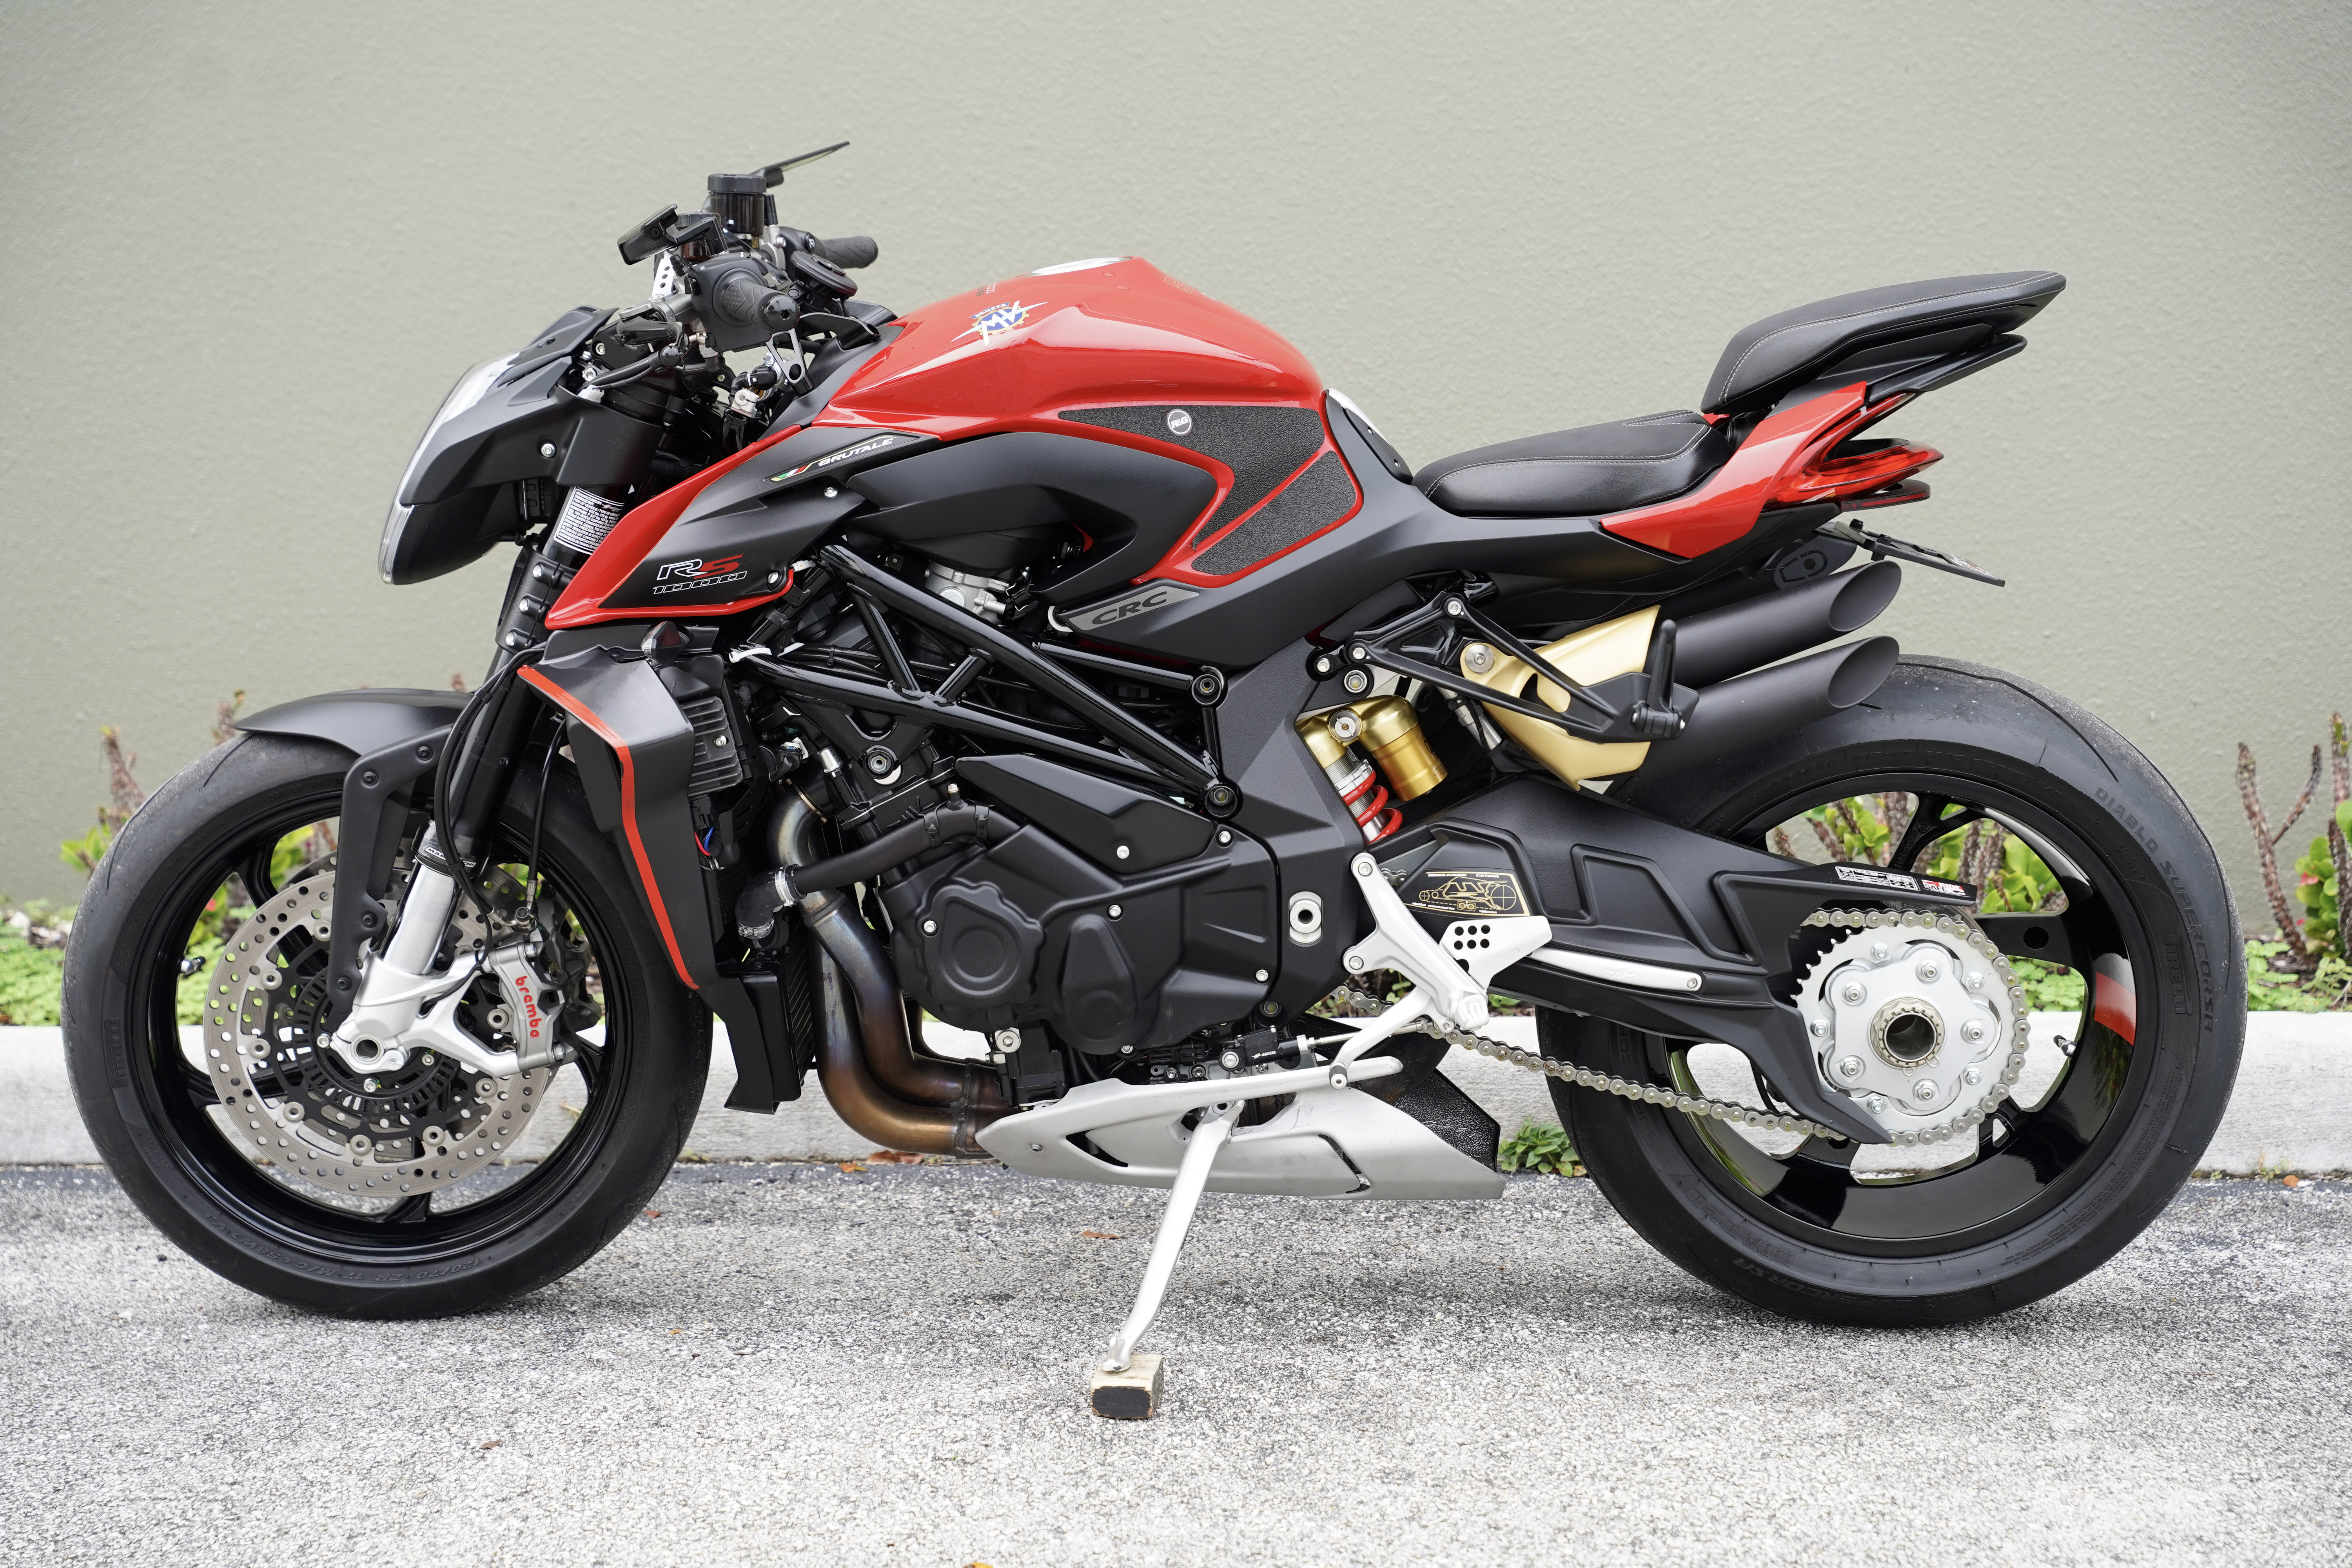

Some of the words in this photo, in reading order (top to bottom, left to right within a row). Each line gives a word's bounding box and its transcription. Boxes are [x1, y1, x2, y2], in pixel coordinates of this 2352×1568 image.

[975, 303, 1007, 318] AGUSTA
[981, 300, 1020, 346] MV
[1171, 416, 1189, 430] R&G
[817, 437, 895, 467] BRUTALE
[657, 554, 744, 581] RS
[653, 571, 748, 595] 1000
[1091, 591, 1168, 626] CRC
[1937, 882, 1961, 890] RIDE
[2093, 786, 2160, 854] DIABLO
[2159, 857, 2214, 1033] SUPERCORSA
[2161, 932, 2194, 1015] PIRELLI
[515, 975, 540, 1039] brembo
[1685, 1188, 1795, 1268] DIABLO
[293, 1258, 336, 1278] M/C
[414, 1256, 482, 1279] 120/70
